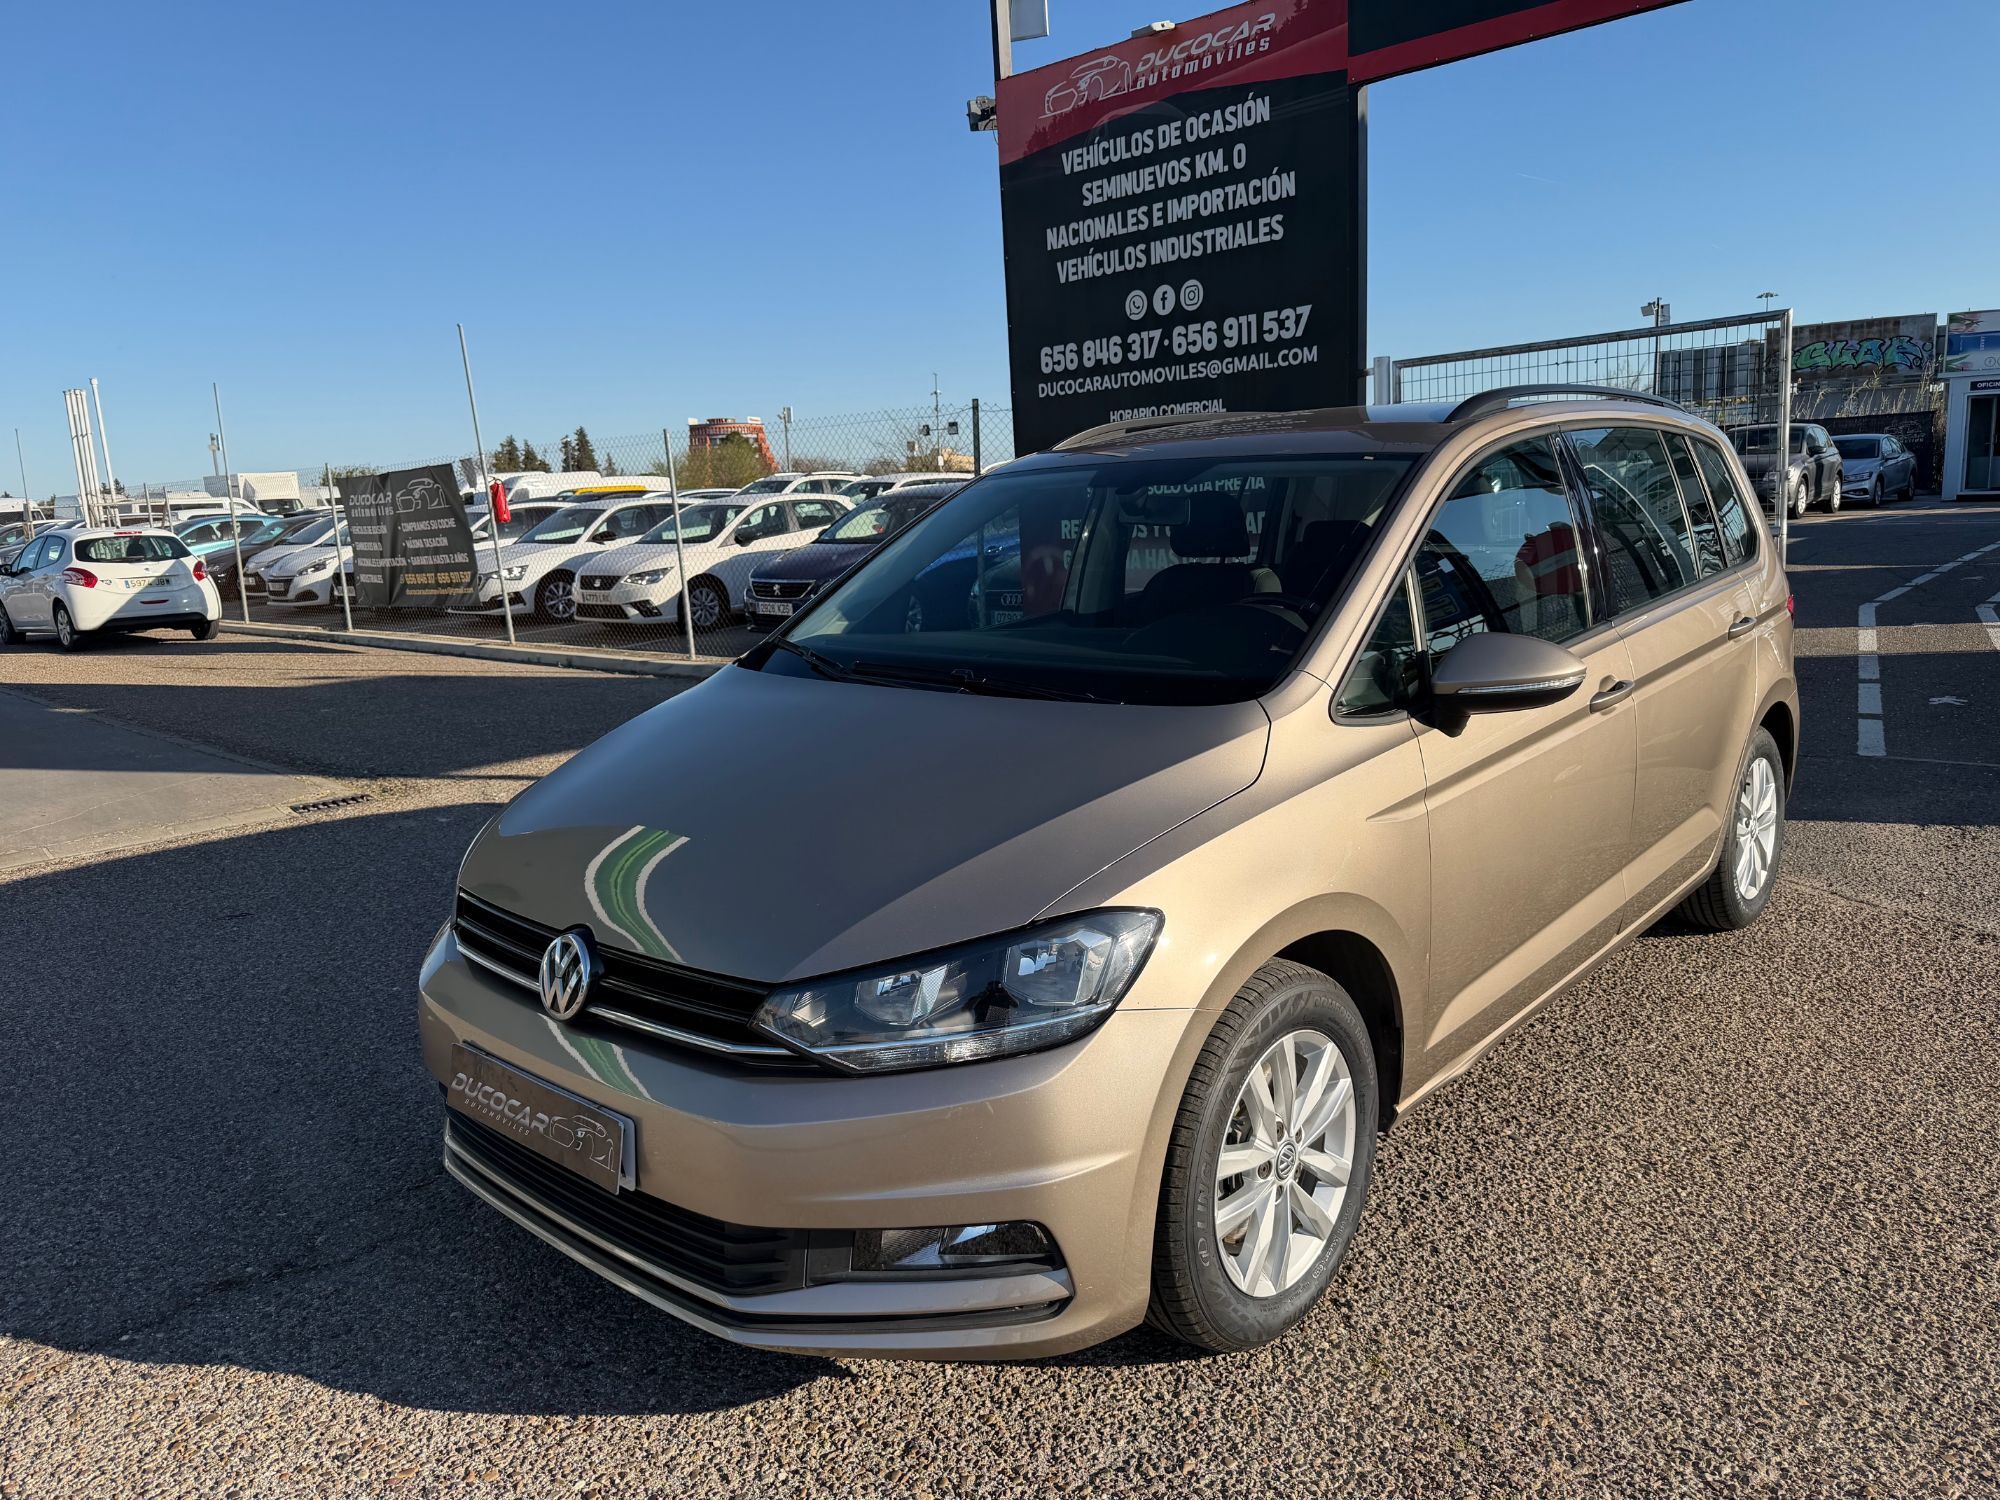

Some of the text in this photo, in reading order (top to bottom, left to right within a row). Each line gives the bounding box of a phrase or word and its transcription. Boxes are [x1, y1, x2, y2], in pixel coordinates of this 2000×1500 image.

[1136, 12, 1276, 73] DUCOCAR
[1062, 92, 1271, 175] VEHÍCULOS DE OCASIÓN
[1082, 157, 1191, 206] SEMINUEVOS
[1195, 148, 1229, 178] KM.
[1046, 167, 1296, 251] NACIONALES E IMPORTACIÓN
[1057, 214, 1284, 284] VEHÍCULOS INDUSTRIALES
[1040, 342, 1079, 374] 656
[1082, 335, 1122, 369] 846
[1223, 314, 1258, 348] 911
[1263, 305, 1312, 341] 537
[1038, 346, 1319, 398] DUCOCARAUTOMOVILES@GMAIL.COM
[1110, 398, 1227, 422] HORARIO COMERCIAL
[349, 492, 393, 506] DUCOCAR
[451, 1072, 549, 1135] DUCOCAR
